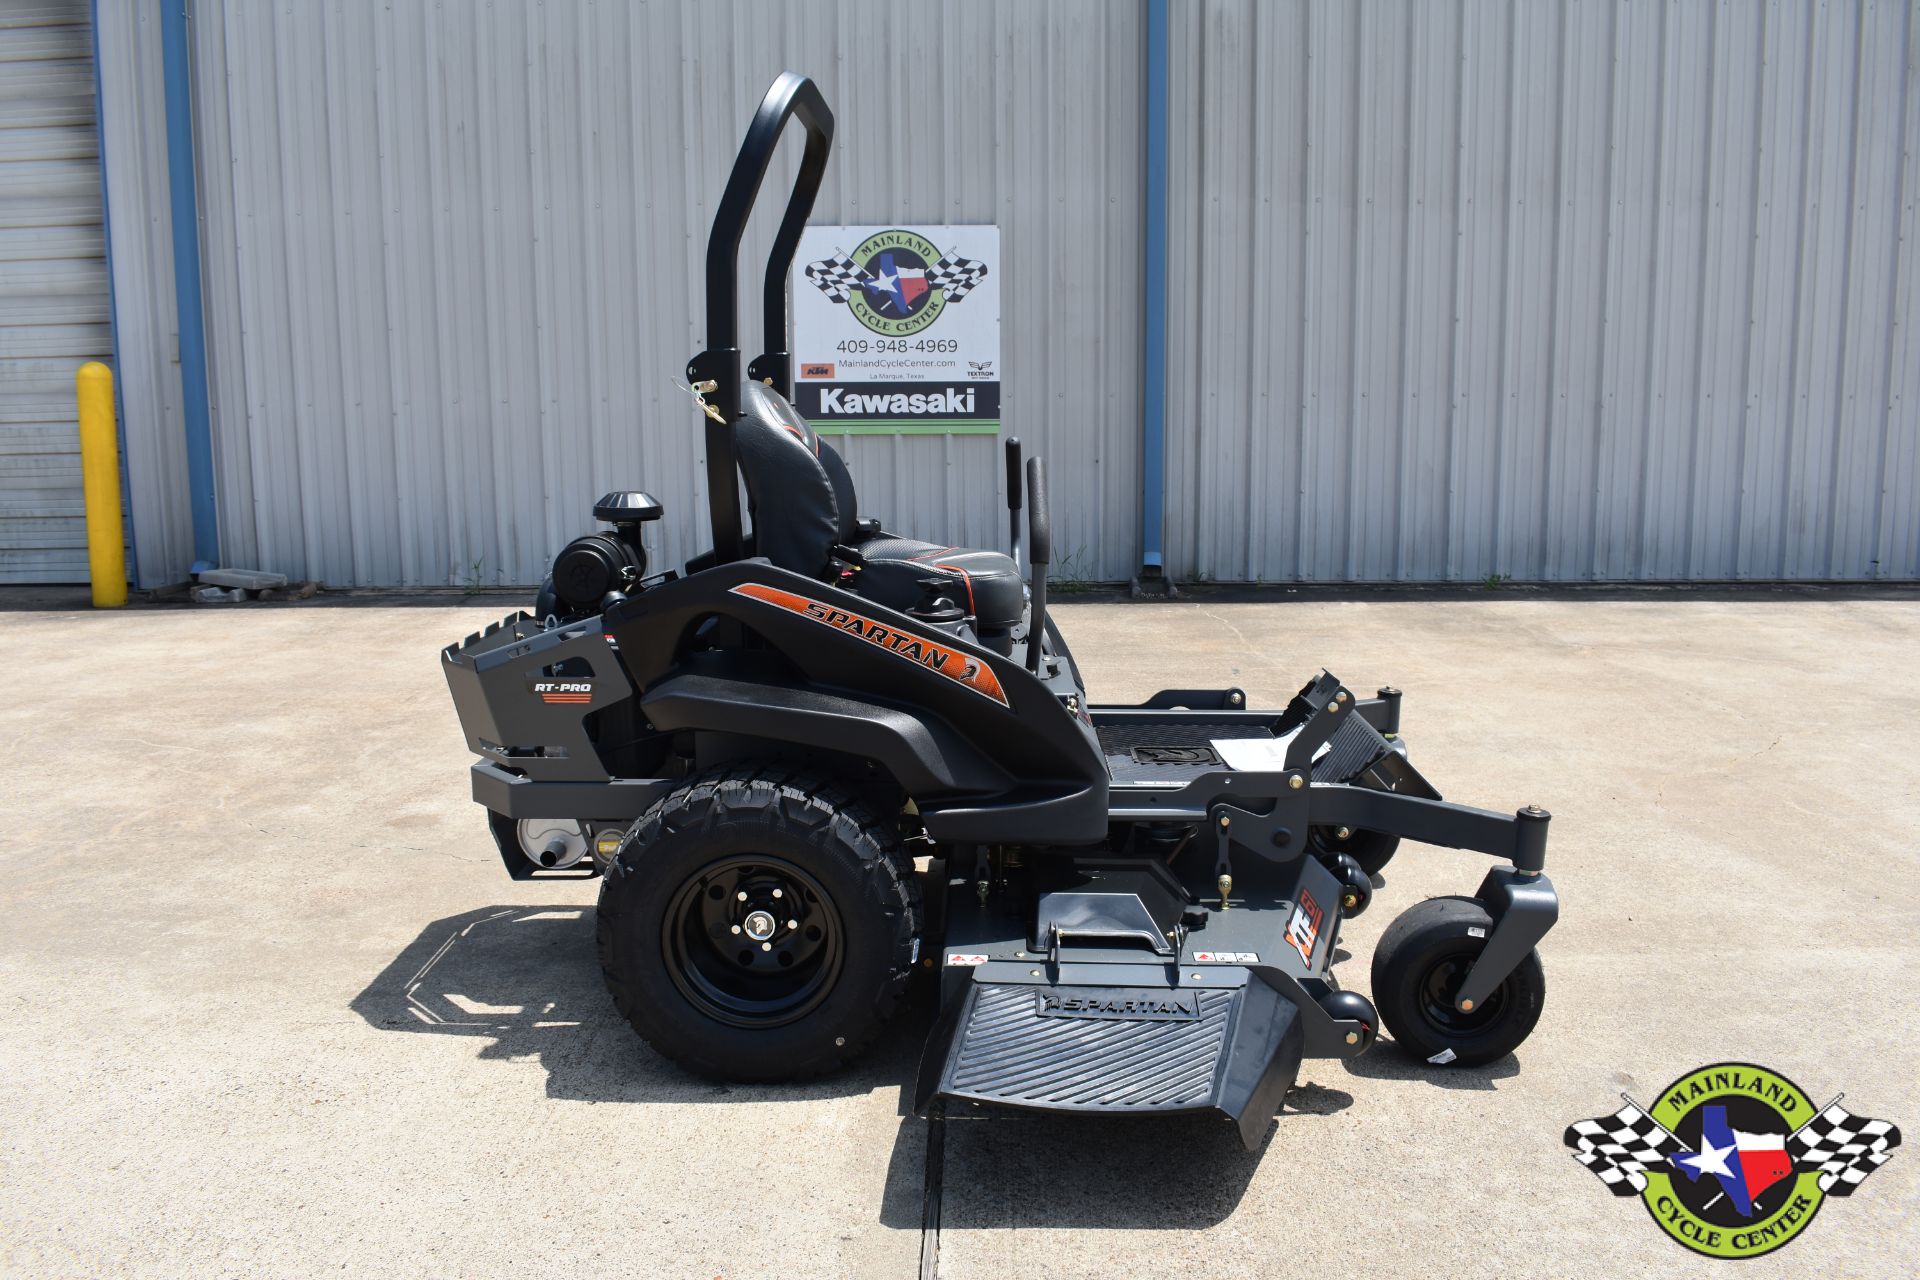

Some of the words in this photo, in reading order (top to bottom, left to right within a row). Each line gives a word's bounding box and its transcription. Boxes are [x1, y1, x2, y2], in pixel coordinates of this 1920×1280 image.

[861, 234, 932, 258] MAINLAND
[855, 302, 890, 331] CYCLE
[896, 301, 940, 332] CENTER
[836, 339, 958, 353] 409-948-4969
[838, 359, 956, 368] MainlandCycleCenter.com
[820, 388, 975, 414] Kawasaki
[803, 602, 949, 671] SPARTAN
[534, 682, 592, 693] RT-PRO
[1063, 999, 1192, 1014] SPARTAN
